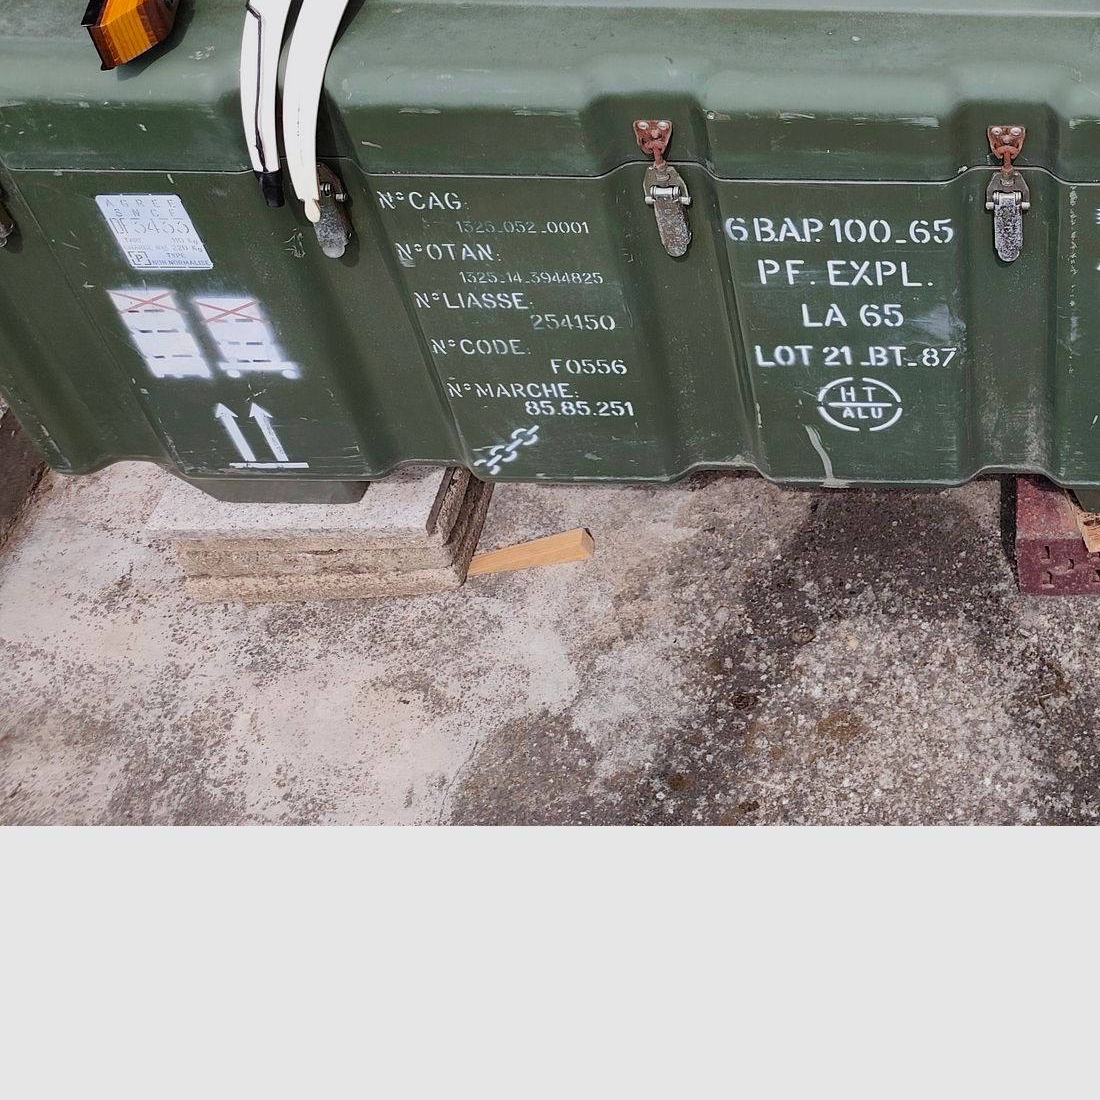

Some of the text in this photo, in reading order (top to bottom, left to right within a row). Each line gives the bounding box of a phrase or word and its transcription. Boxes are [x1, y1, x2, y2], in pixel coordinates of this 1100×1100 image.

[134, 254, 144, 262] P
[827, 260, 934, 287] EXPL.
[530, 313, 617, 331] 254150
[801, 303, 904, 327] LA 65
[754, 345, 813, 367] LOT
[525, 400, 635, 417] 85.85.251
[842, 406, 882, 419] ALU
